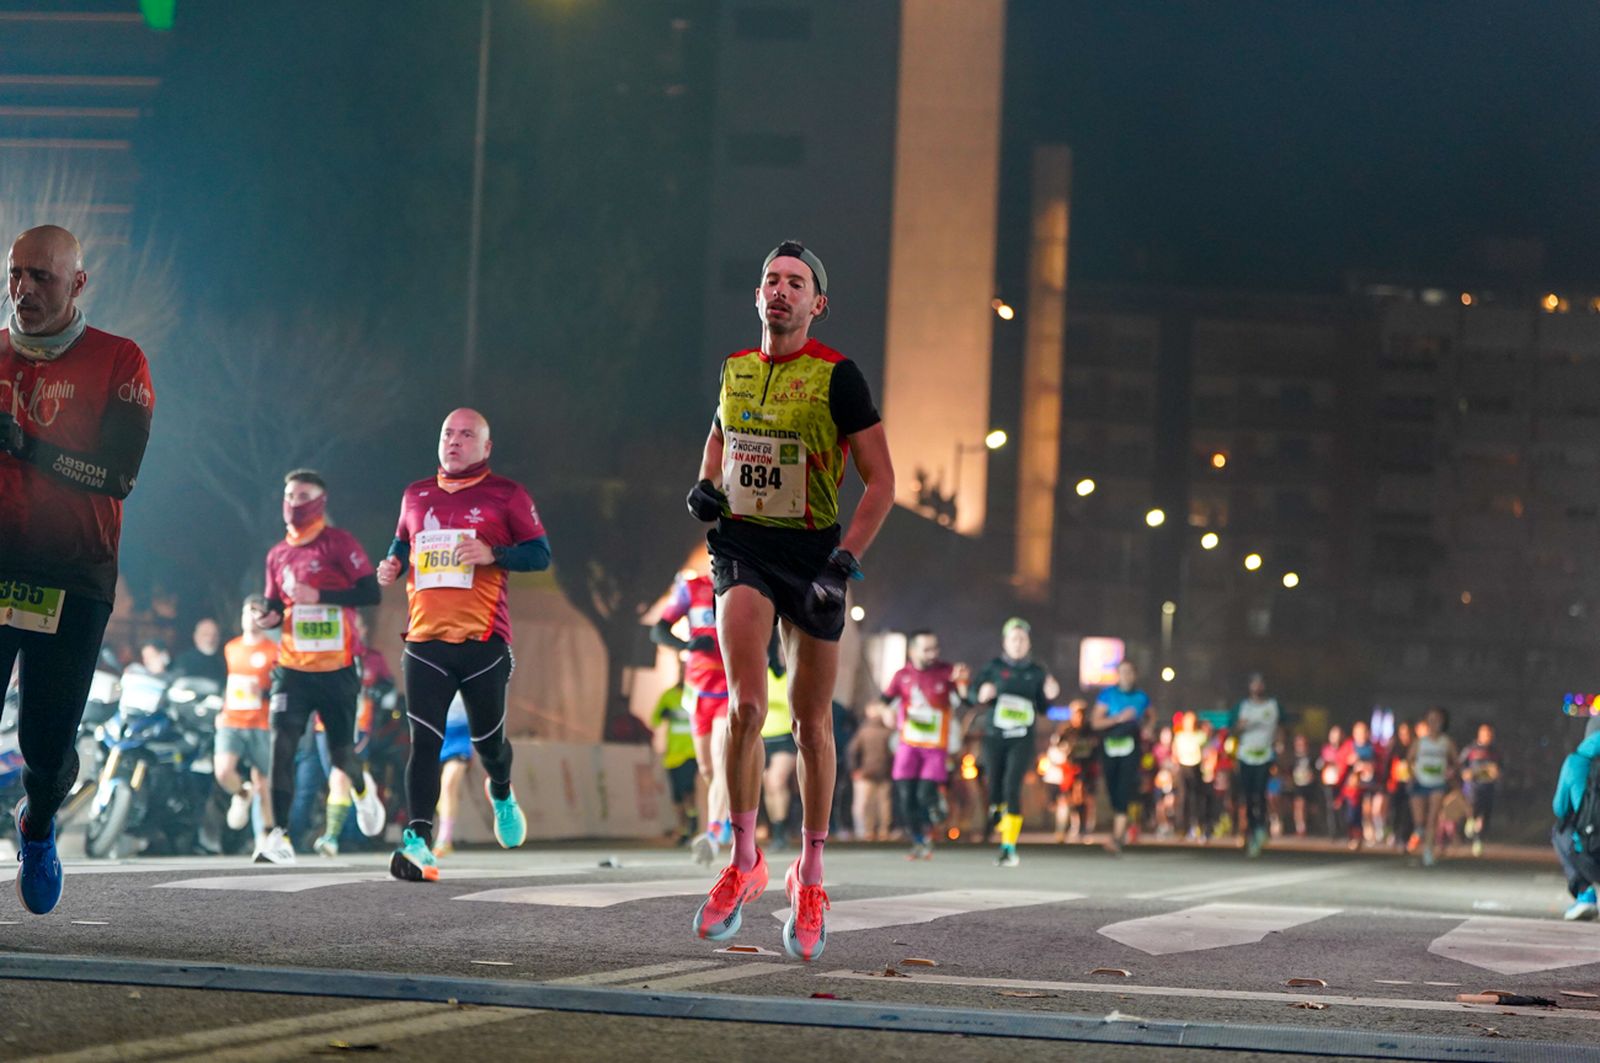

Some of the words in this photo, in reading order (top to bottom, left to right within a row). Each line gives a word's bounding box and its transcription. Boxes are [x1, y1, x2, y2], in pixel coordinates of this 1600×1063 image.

[738, 443, 761, 454] NOCHE
[762, 446, 772, 456] DE
[52, 462, 105, 488] MUNDO
[57, 454, 107, 479] HOBBY
[740, 464, 782, 490] 834
